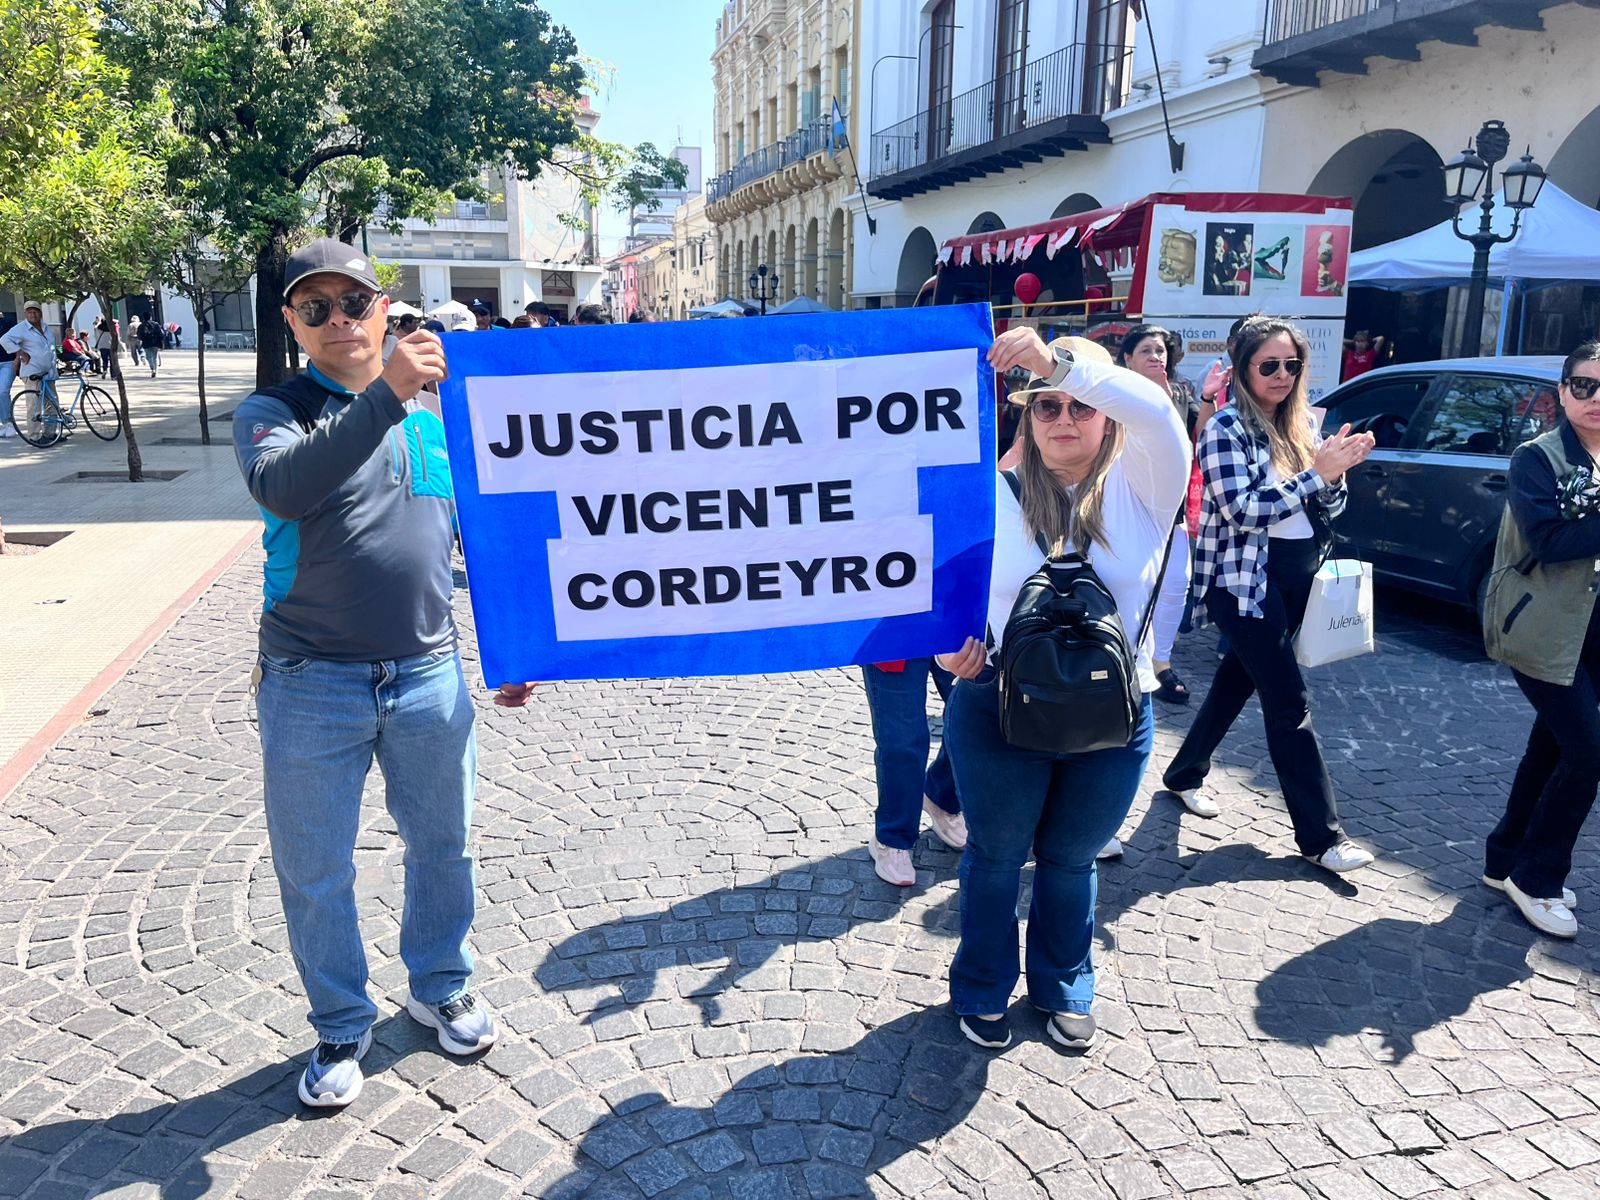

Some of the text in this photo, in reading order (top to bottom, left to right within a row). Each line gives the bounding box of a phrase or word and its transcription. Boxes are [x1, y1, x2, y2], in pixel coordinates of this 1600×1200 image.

[1189, 342, 1227, 352] conoc
[1202, 330, 1217, 339] en
[488, 388, 966, 458] JUSTICIA POR
[571, 479, 854, 536] VICENTE
[567, 551, 916, 610] CORDEYRO
